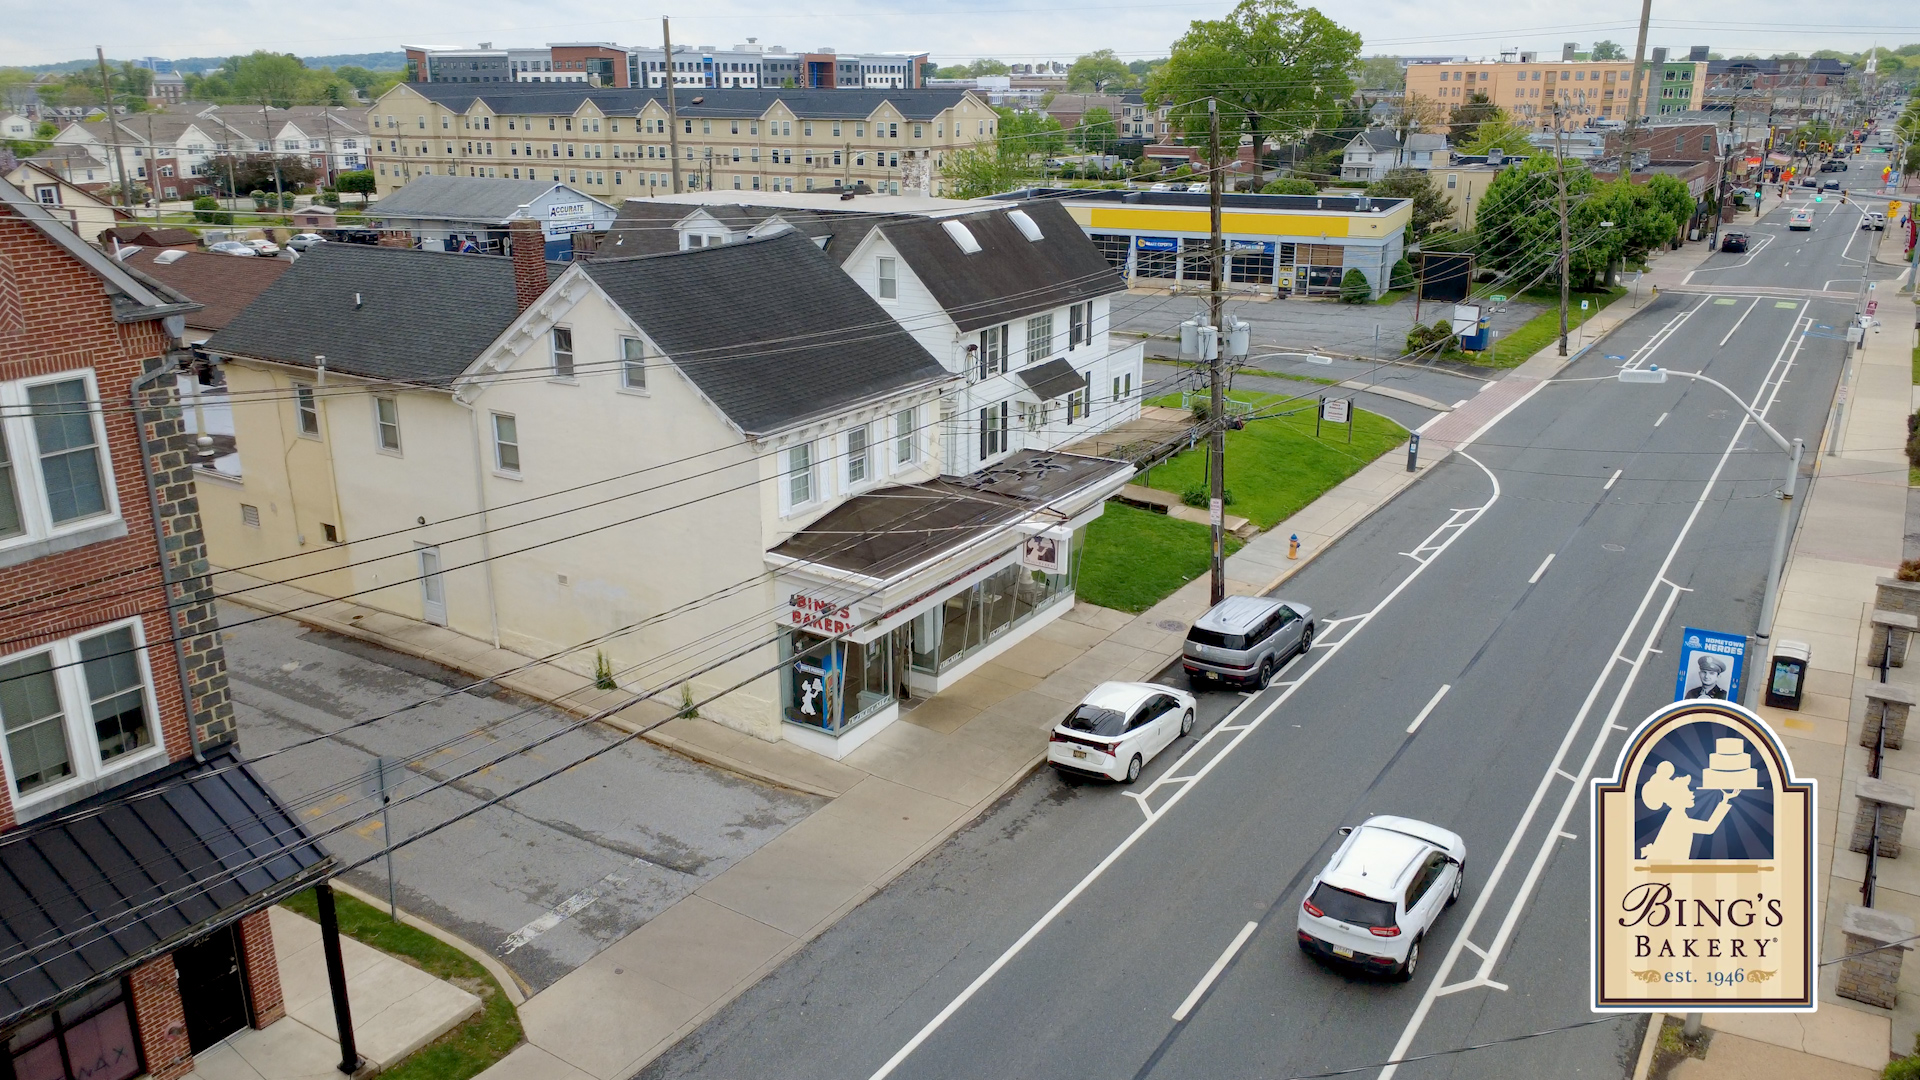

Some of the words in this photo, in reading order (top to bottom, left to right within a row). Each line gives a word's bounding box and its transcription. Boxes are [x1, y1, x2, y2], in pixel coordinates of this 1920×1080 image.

[550, 204, 584, 217] ACCURATE
[792, 610, 856, 637] BAKERY
[1705, 637, 1745, 648] HOMETOWN
[1704, 643, 1743, 655] HEROES
